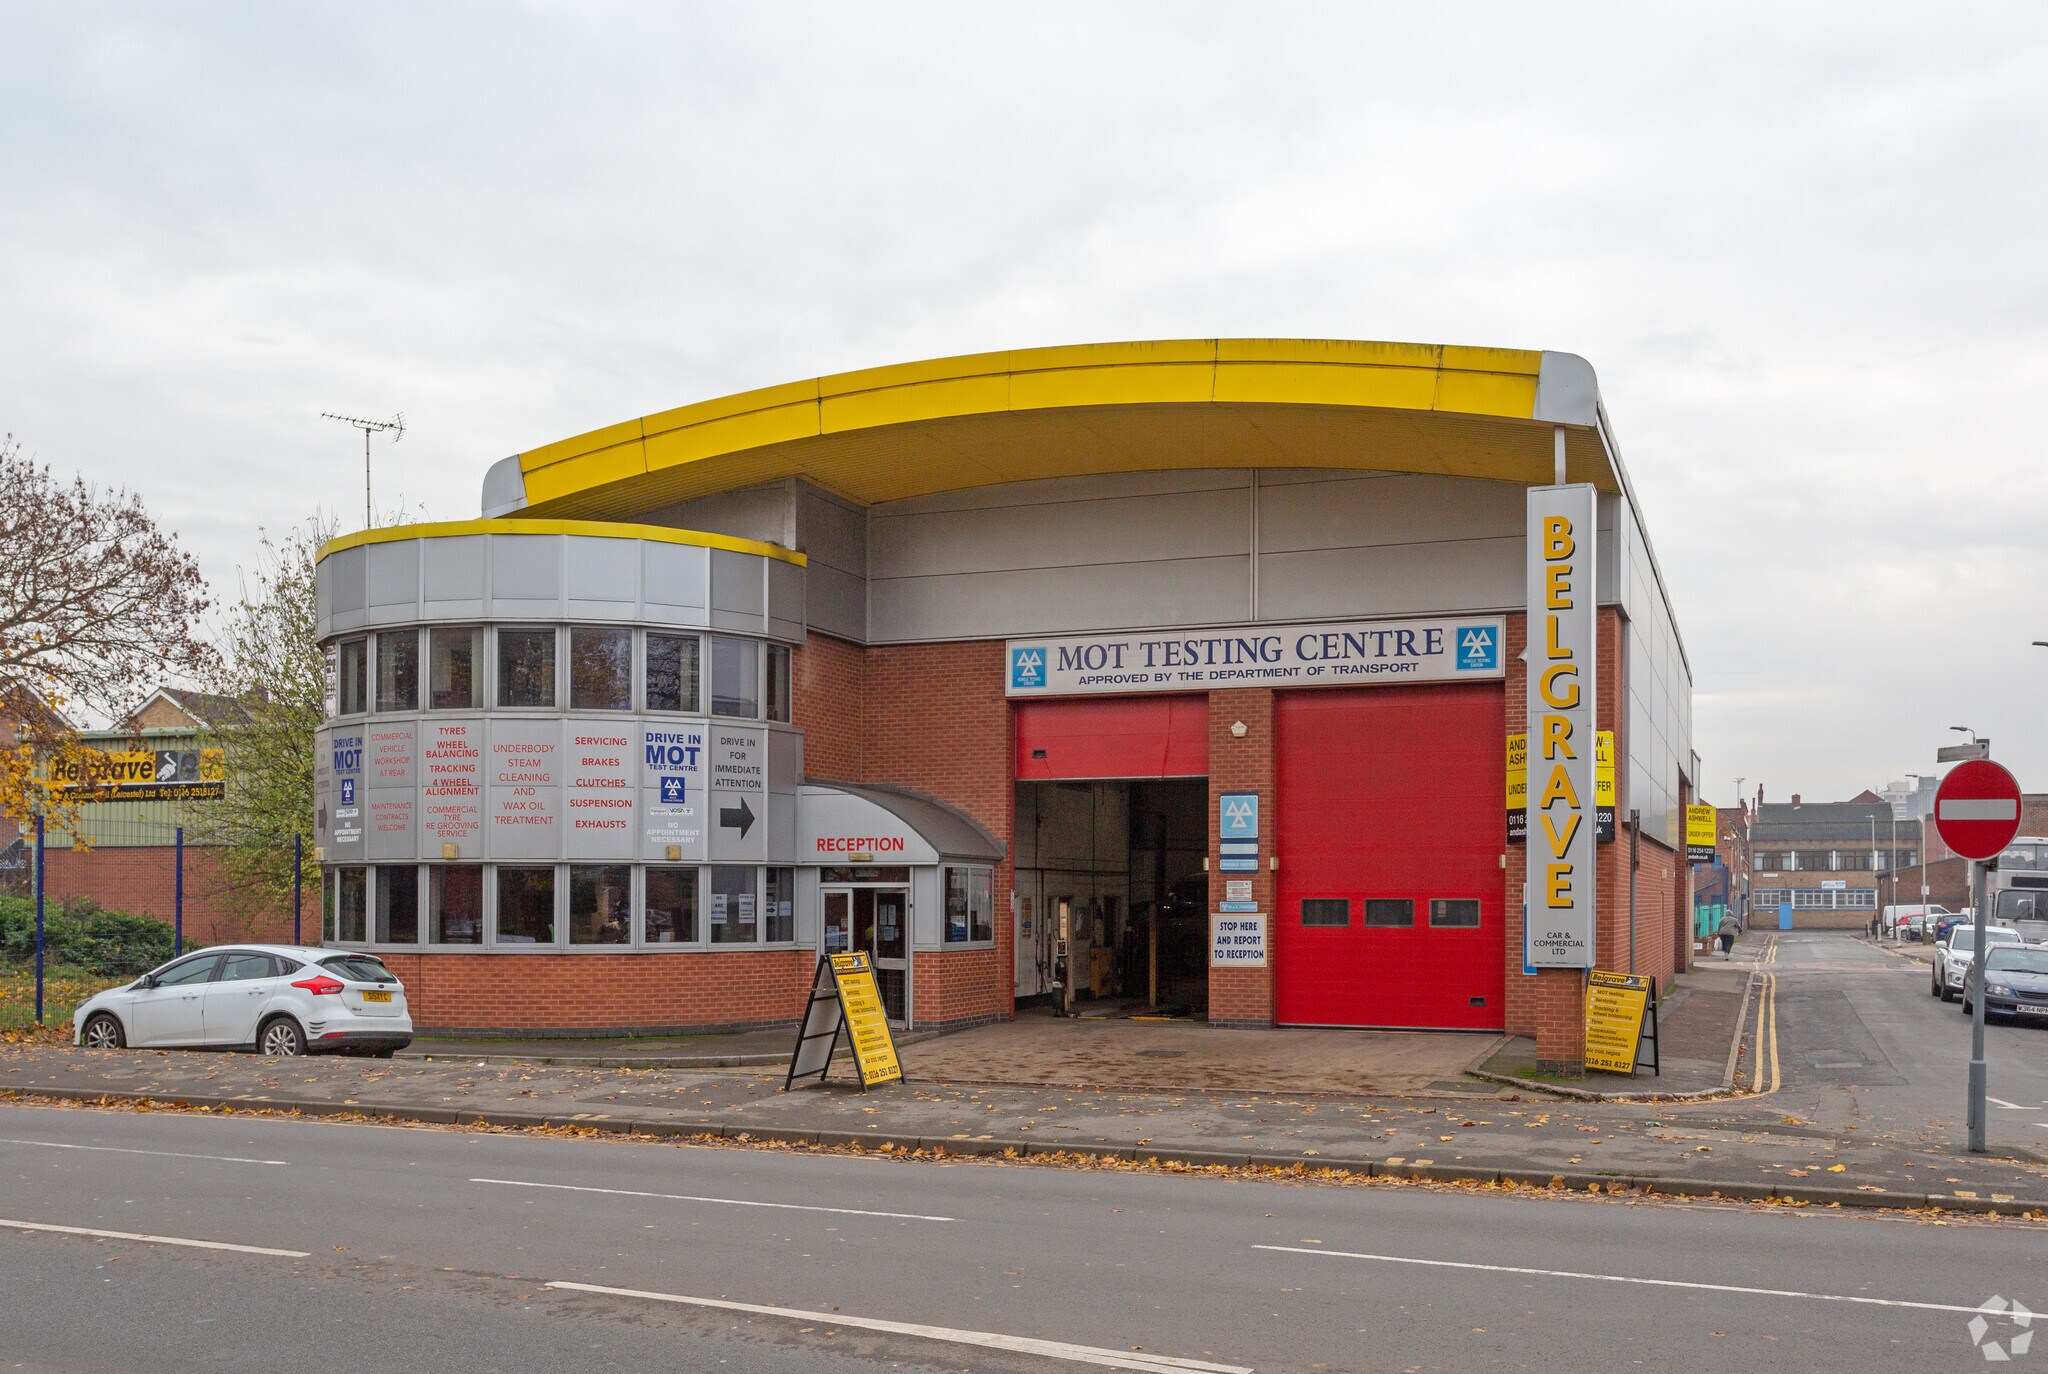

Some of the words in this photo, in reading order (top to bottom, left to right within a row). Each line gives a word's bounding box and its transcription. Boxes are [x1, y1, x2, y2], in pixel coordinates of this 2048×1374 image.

[1057, 643, 1129, 671] MOT
[1139, 635, 1283, 668] TESTING
[1295, 628, 1444, 661] CENTRE
[1078, 673, 1149, 685] APPROVED
[1154, 672, 1172, 682] BY
[1178, 671, 1203, 681] THE
[1209, 667, 1300, 680] DEPARTMENT
[1306, 666, 1325, 676] OF
[1331, 663, 1419, 675] TRANSPORT
[1538, 515, 1582, 909] BELGRAVE
[439, 727, 466, 735] TYRES
[371, 732, 413, 741] COMMERCIAL
[646, 733, 684, 743] DRIVE
[688, 735, 701, 744] IN
[334, 738, 353, 749] DRIVE
[355, 737, 362, 746] IN
[436, 741, 468, 749] WHEEL
[575, 737, 627, 746] SERVICING
[720, 737, 745, 746] DRIVE
[747, 739, 756, 747] IN
[493, 744, 555, 753] UNDERBODY
[426, 749, 479, 758] BALANCING
[646, 745, 700, 765] MOT
[730, 752, 746, 760] FOR
[334, 749, 362, 769] MOT
[375, 757, 410, 765] WORKSHOP
[508, 759, 541, 767] STEAM
[582, 758, 620, 766] BRAKES
[430, 765, 475, 773] TRACKING
[715, 765, 760, 774] IMMEDIATE
[498, 773, 550, 781] CLEANING
[576, 779, 626, 787] CLUTCHES
[715, 778, 761, 788] ATTENTION
[426, 787, 479, 796] ALIGNMENT
[513, 787, 536, 796] AND
[371, 802, 413, 810] MAINTENANCE
[503, 802, 526, 810] WAX
[529, 802, 545, 810] OIL
[570, 799, 632, 808] SUSPENSION
[427, 806, 478, 814] COMMERCIAL
[494, 816, 554, 825] TREATMENT
[575, 820, 626, 829] EXHAUSTS
[1509, 815, 1523, 825] 0116
[437, 822, 479, 830] GROOVING
[817, 837, 904, 851] RECEPTION
[1220, 922, 1238, 931] STOP
[1240, 922, 1257, 931] HERE
[1217, 936, 1231, 945] AND
[1234, 936, 1261, 945] REPORT
[1214, 950, 1225, 959] TO
[1226, 950, 1264, 959] RECEPTION
[1551, 948, 1566, 956] LTD
[1593, 973, 1626, 983] Belgrave
[1613, 1061, 1631, 1069] 8127
